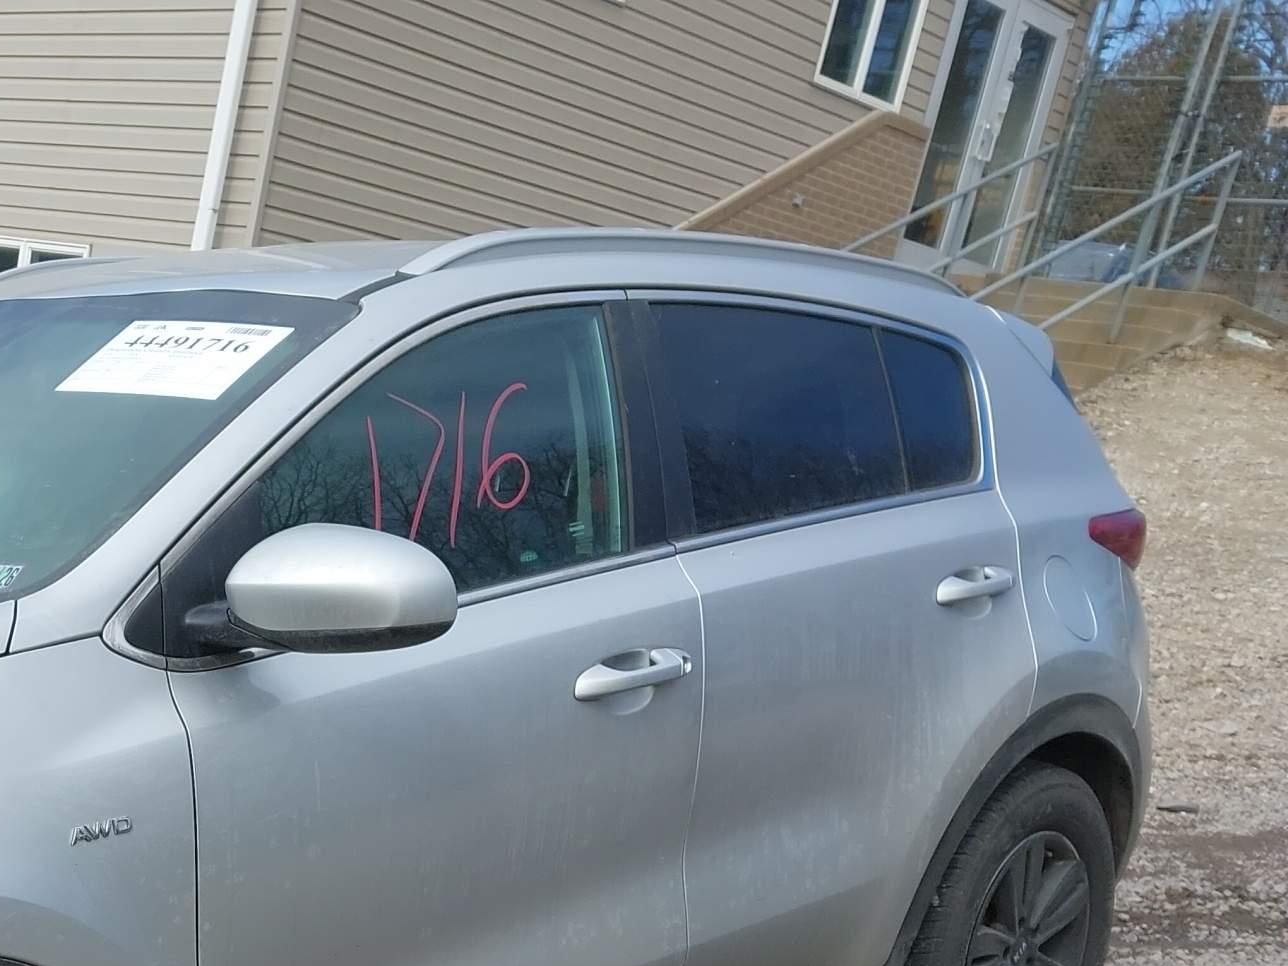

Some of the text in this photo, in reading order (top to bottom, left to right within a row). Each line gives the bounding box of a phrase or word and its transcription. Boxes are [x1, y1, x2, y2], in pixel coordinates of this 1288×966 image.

[124, 335, 251, 353] 44491716
[367, 382, 531, 548] 1716
[71, 816, 132, 846] AWD
